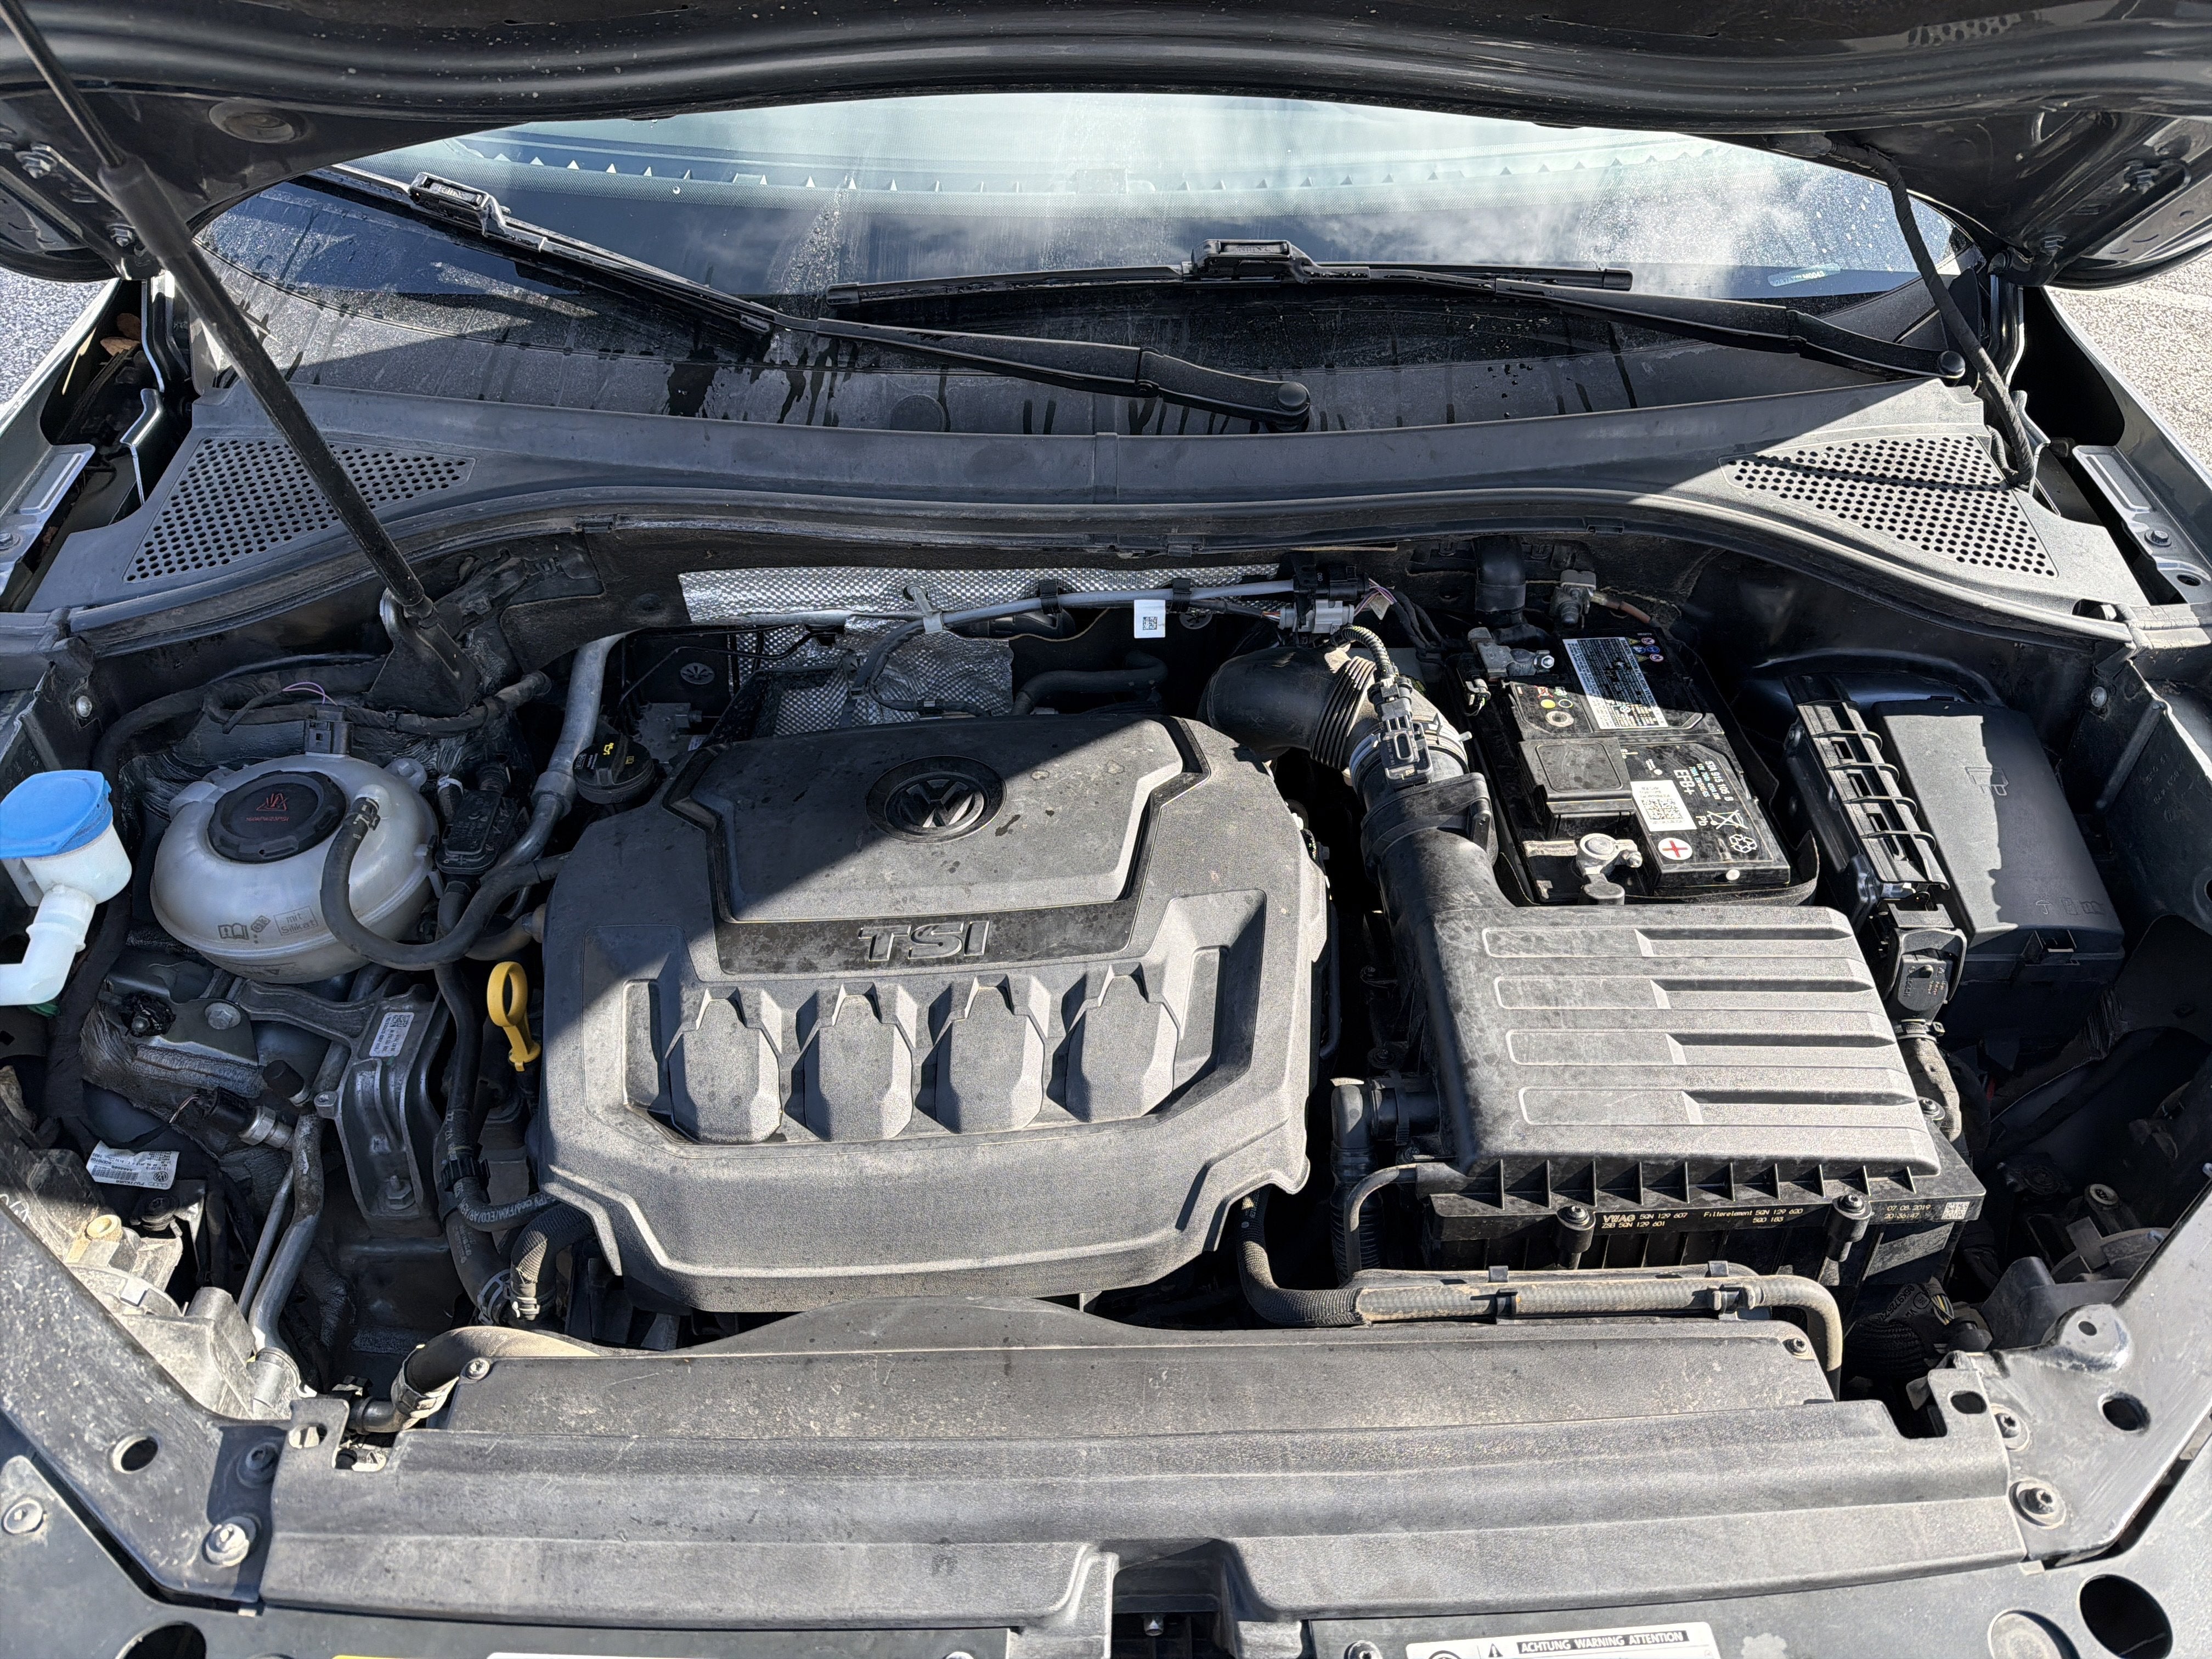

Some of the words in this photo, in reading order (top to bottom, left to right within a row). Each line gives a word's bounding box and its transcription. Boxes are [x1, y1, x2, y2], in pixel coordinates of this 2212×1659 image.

[1705, 760, 1716, 772] 5TA
[1673, 769, 1695, 795] EFB+
[1711, 771, 1724, 783] 915
[1717, 783, 1730, 795] 105
[1695, 815, 1709, 826] Pb
[286, 912, 302, 924] mit
[281, 919, 316, 934] Silikat
[859, 921, 991, 962] TSI
[1886, 1204, 1932, 1212] 07.08.2019
[1603, 1214, 1636, 1223] VWAG
[1520, 1639, 1571, 1654] ACHTUNG
[1574, 1635, 1625, 1649] WARNING
[1629, 1632, 1684, 1645] ATTENTION
